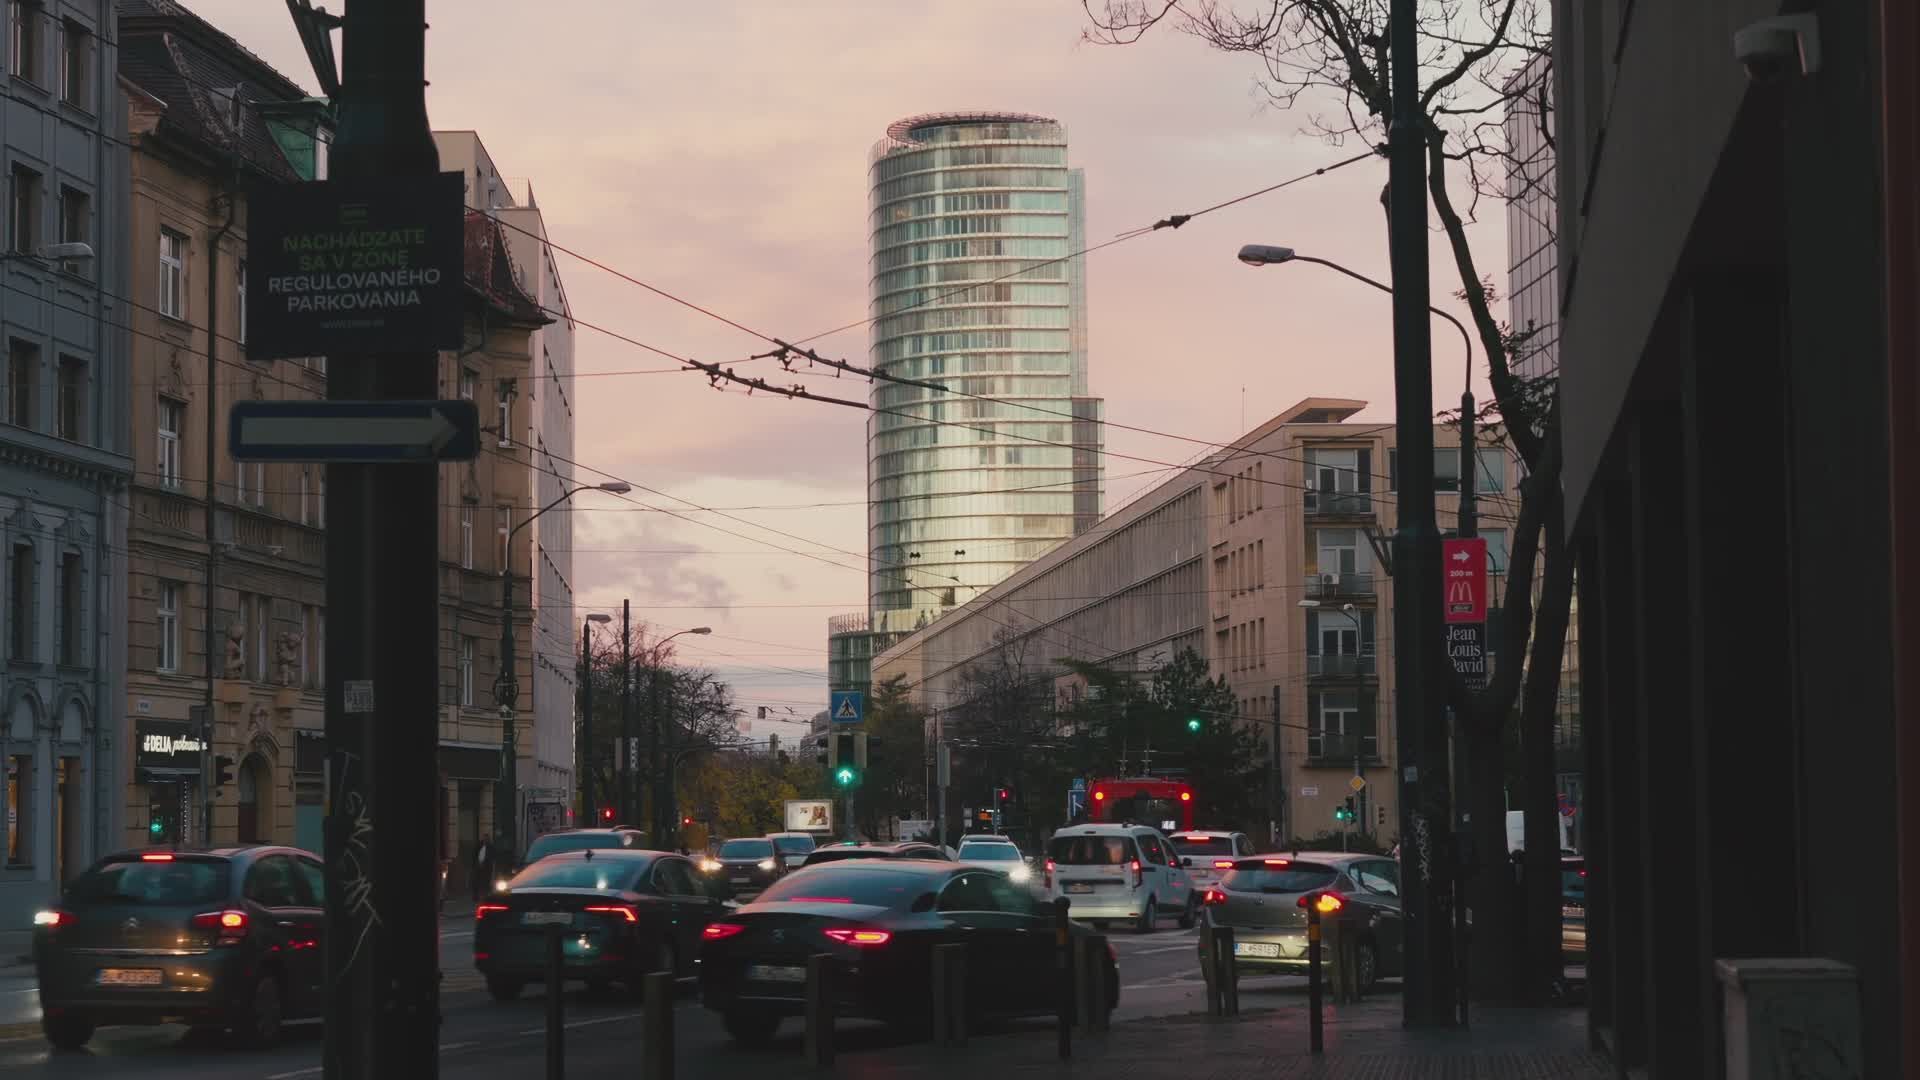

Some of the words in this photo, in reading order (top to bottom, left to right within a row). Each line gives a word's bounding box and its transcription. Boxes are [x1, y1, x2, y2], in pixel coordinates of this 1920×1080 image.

[299, 254, 329, 271] SA
[330, 253, 346, 270] V
[268, 266, 441, 294] REGULOVANÉHO
[287, 289, 421, 313] PARKOVANIA
[1446, 625, 1476, 641] Jean
[1447, 641, 1481, 657] Louis
